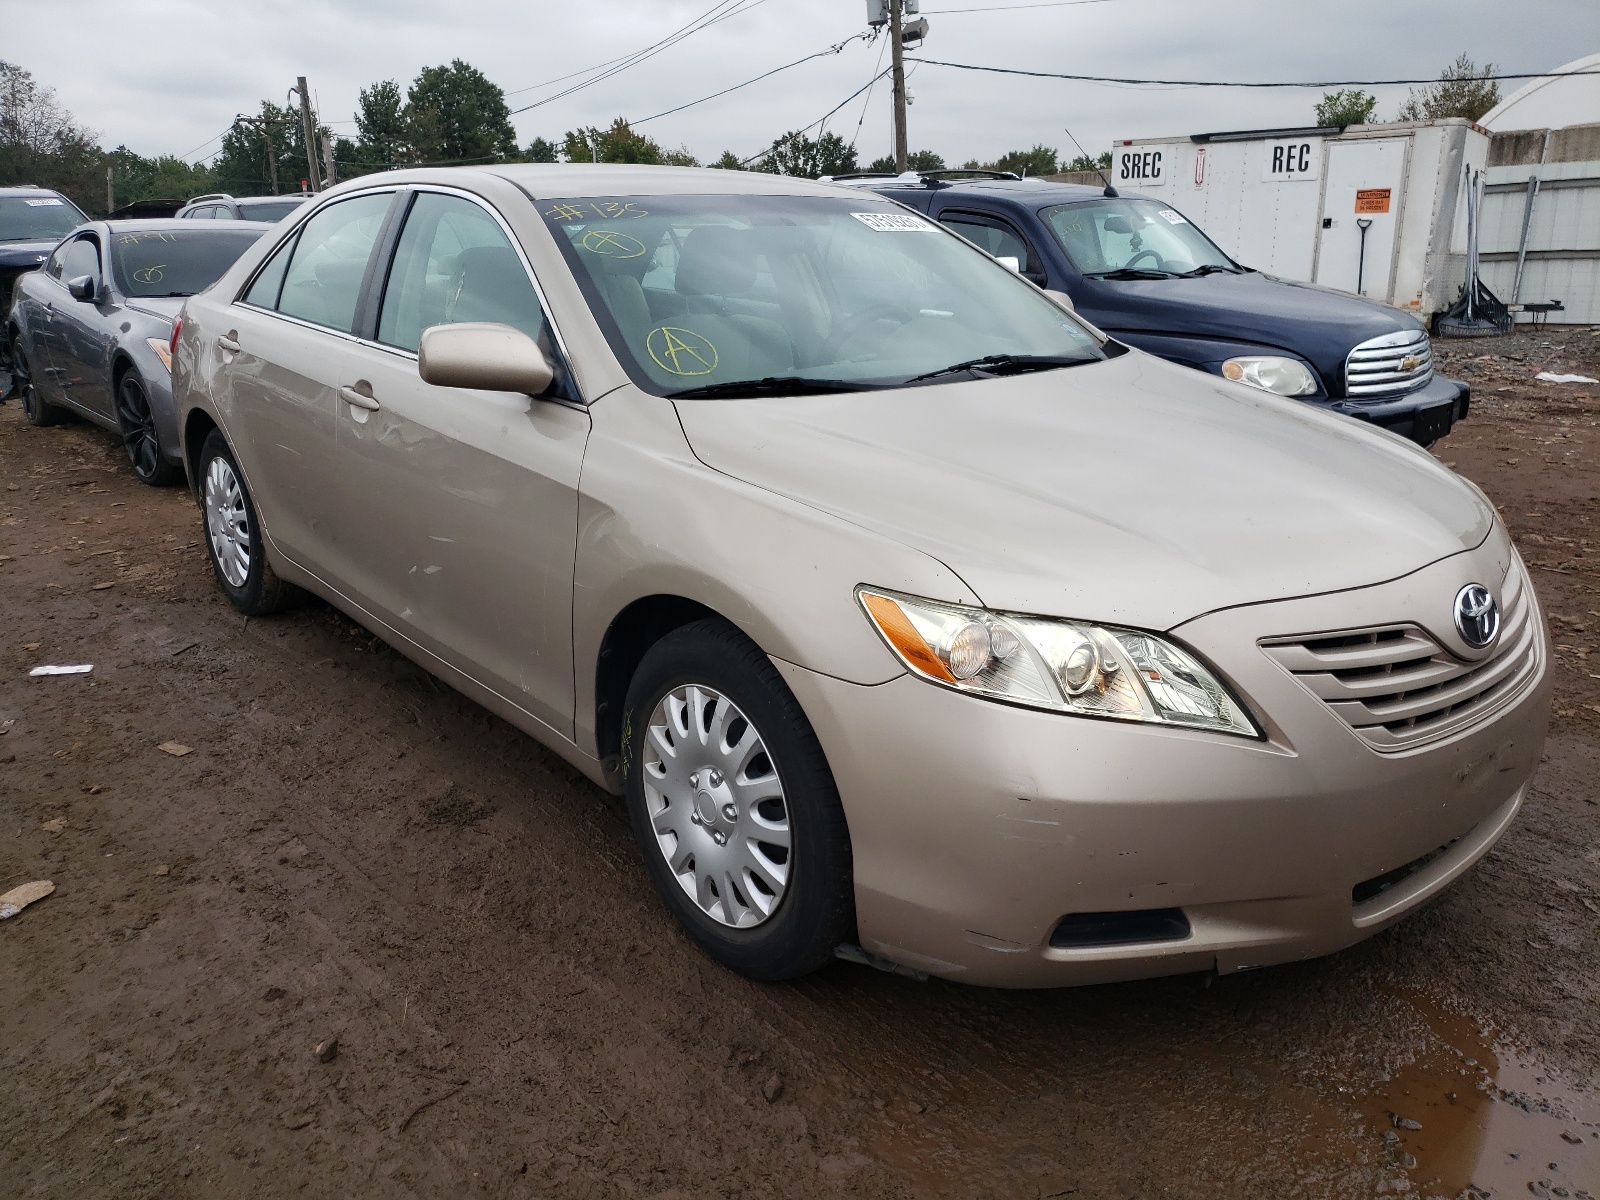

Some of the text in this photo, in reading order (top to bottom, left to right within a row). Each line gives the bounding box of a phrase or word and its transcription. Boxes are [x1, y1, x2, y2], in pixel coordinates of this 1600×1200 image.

[1121, 152, 1162, 179] SREC
[1272, 144, 1310, 173] REC
[661, 326, 712, 373] A
